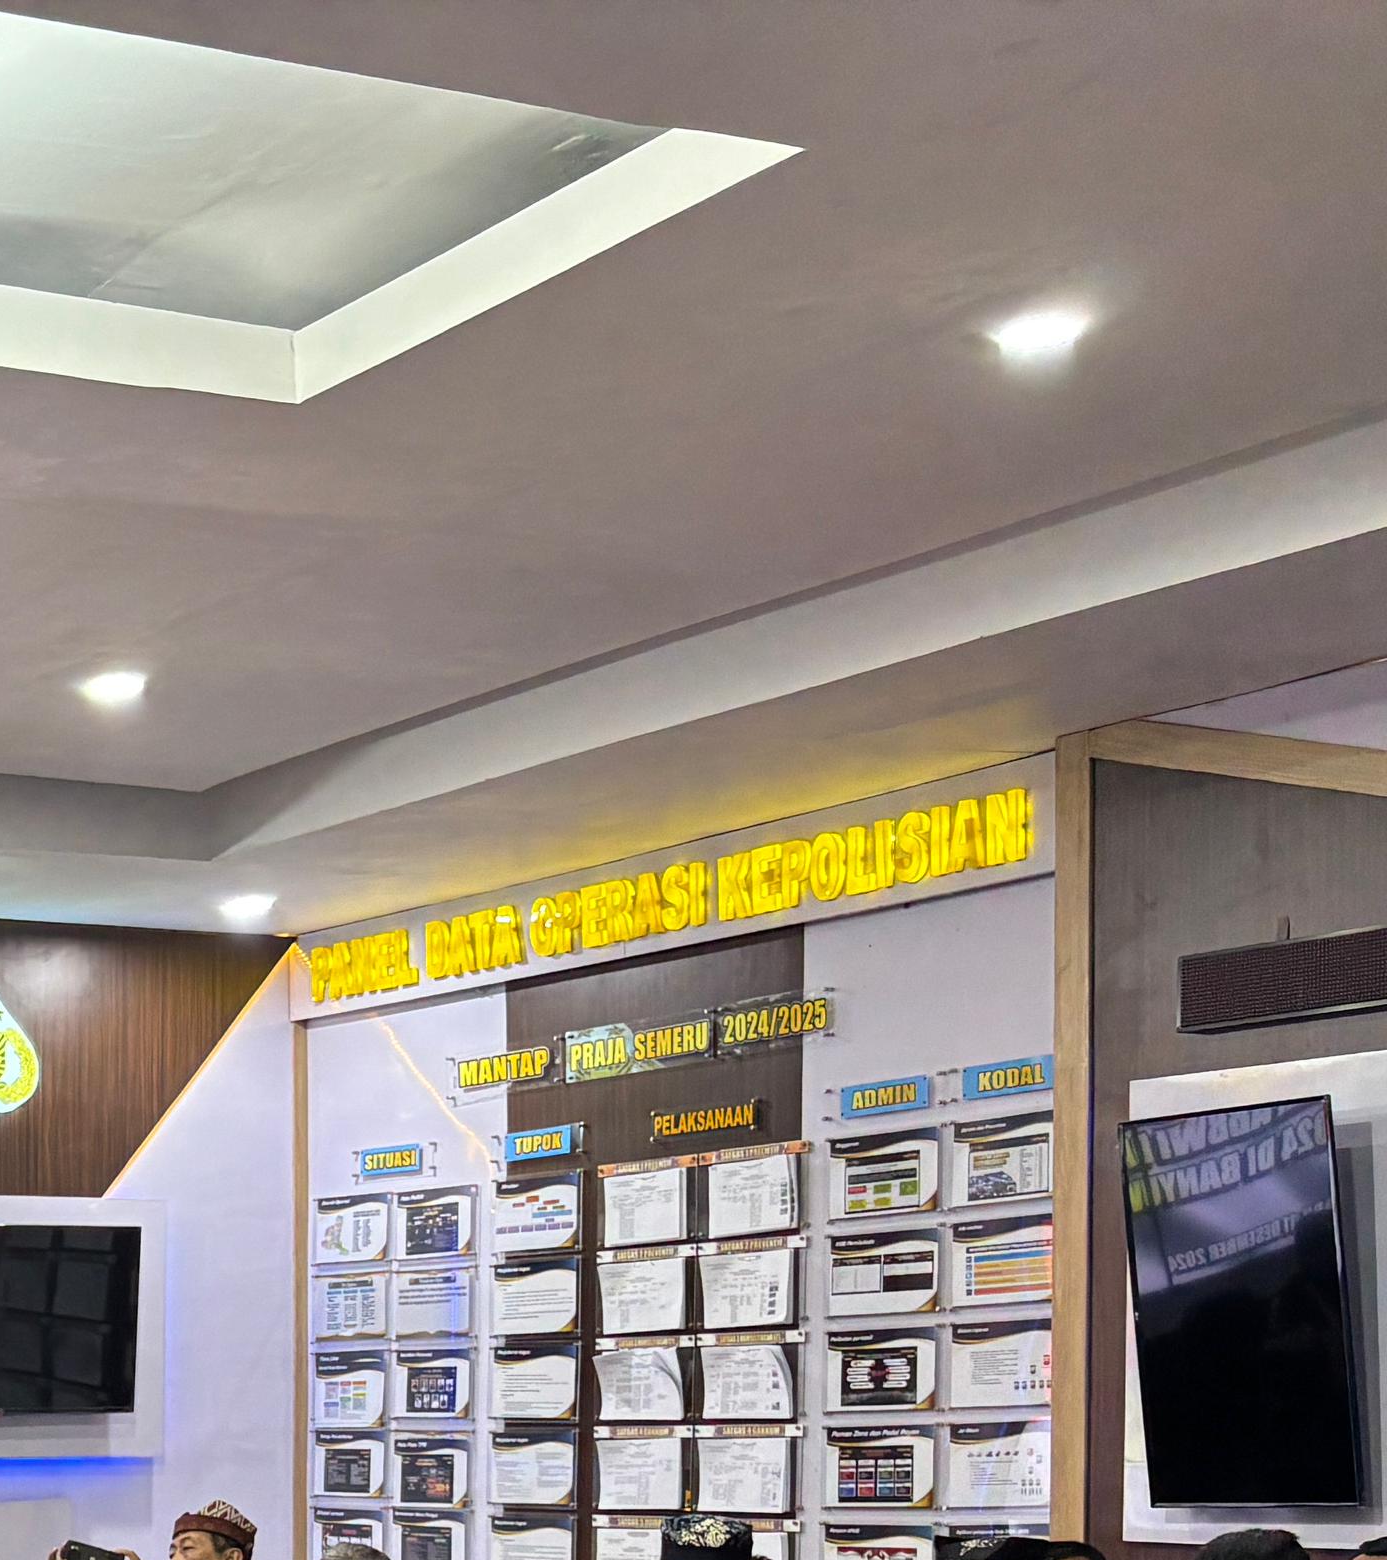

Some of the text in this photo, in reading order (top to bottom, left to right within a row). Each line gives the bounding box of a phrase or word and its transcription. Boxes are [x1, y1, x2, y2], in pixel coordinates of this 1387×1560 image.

[310, 788, 1031, 1003] PANEL DATA OPERASI KEPOLISIAN
[458, 999, 828, 1089] MANTAP PRAJA SEMERU 2024/2025
[978, 1063, 1045, 1092] KODAL
[851, 1083, 917, 1111] ADMIN
[654, 1104, 754, 1138] PELAKSANAAN
[514, 1132, 564, 1155] TUPOK
[364, 1150, 417, 1171] SITUASI
